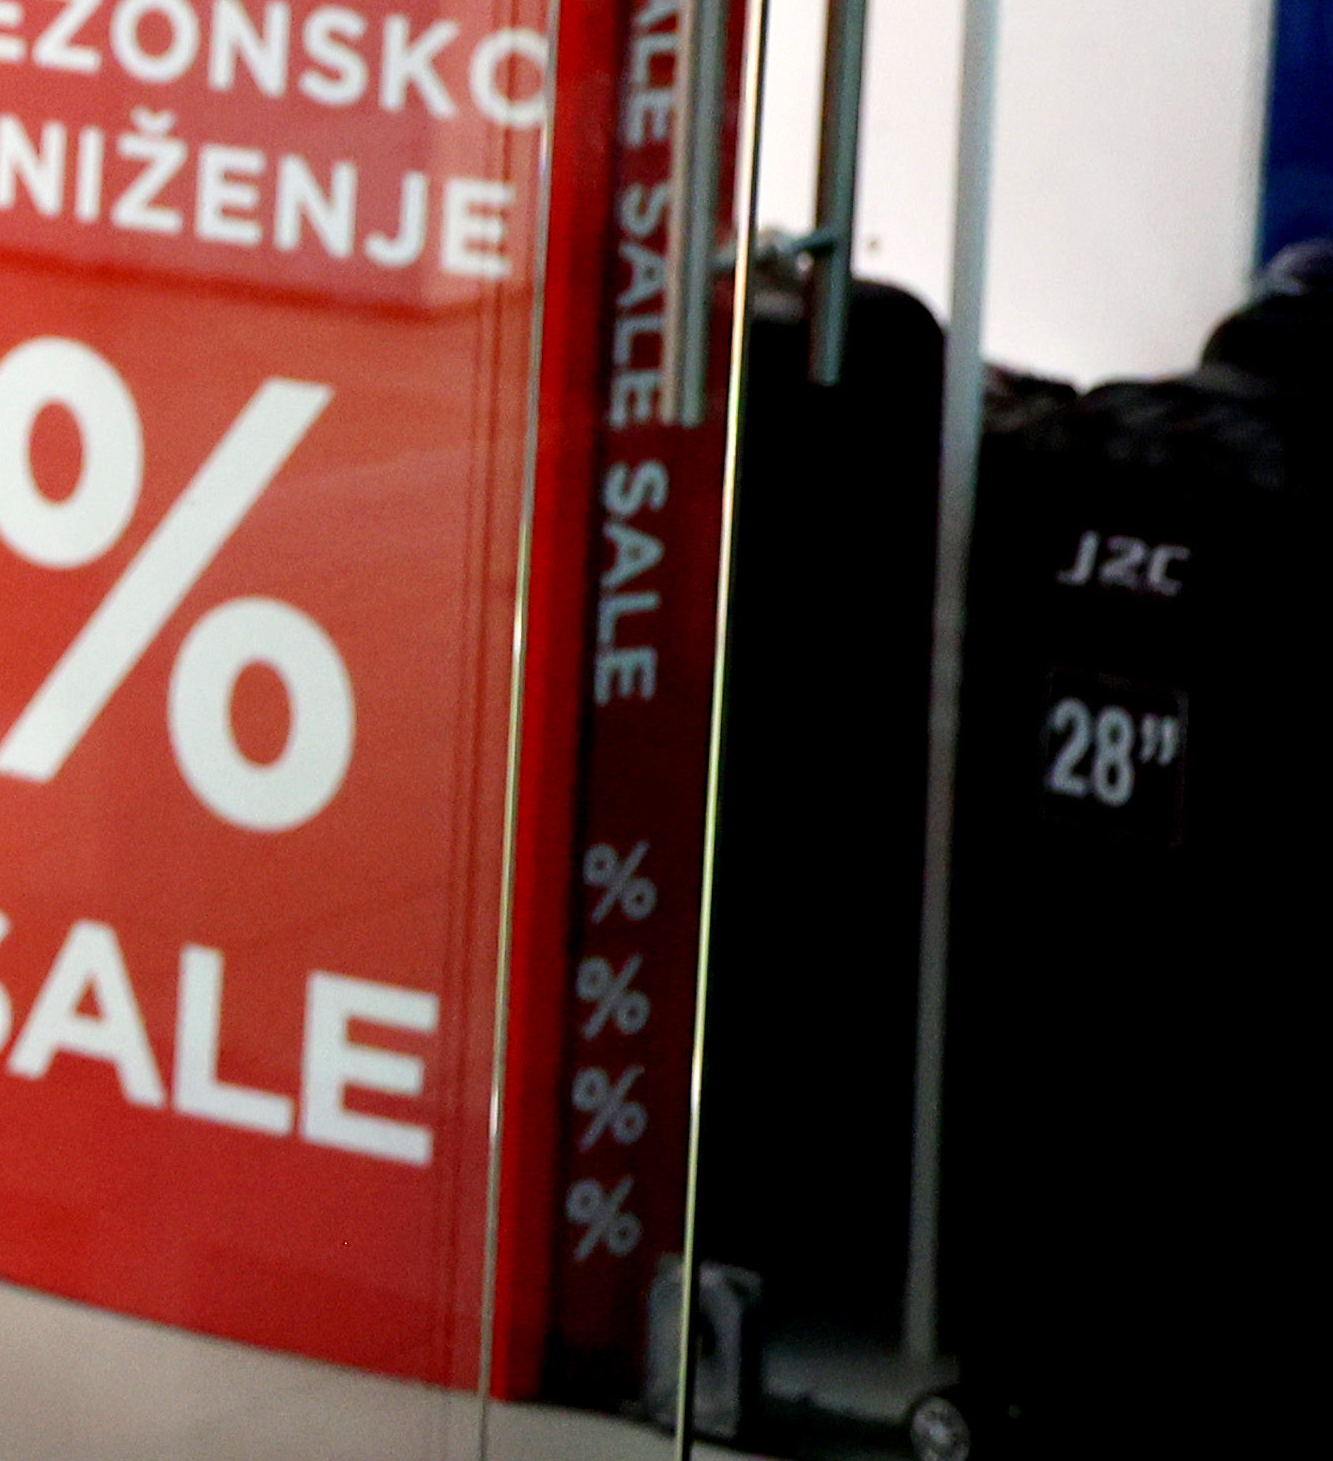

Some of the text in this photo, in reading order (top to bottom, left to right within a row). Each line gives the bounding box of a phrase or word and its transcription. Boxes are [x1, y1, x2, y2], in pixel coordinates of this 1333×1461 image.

[609, 182, 669, 428] SALE
[594, 460, 669, 705] SALE
[583, 841, 657, 924] %
[575, 954, 649, 1039] %
[571, 1065, 647, 1150] %
[565, 1176, 641, 1262] %
